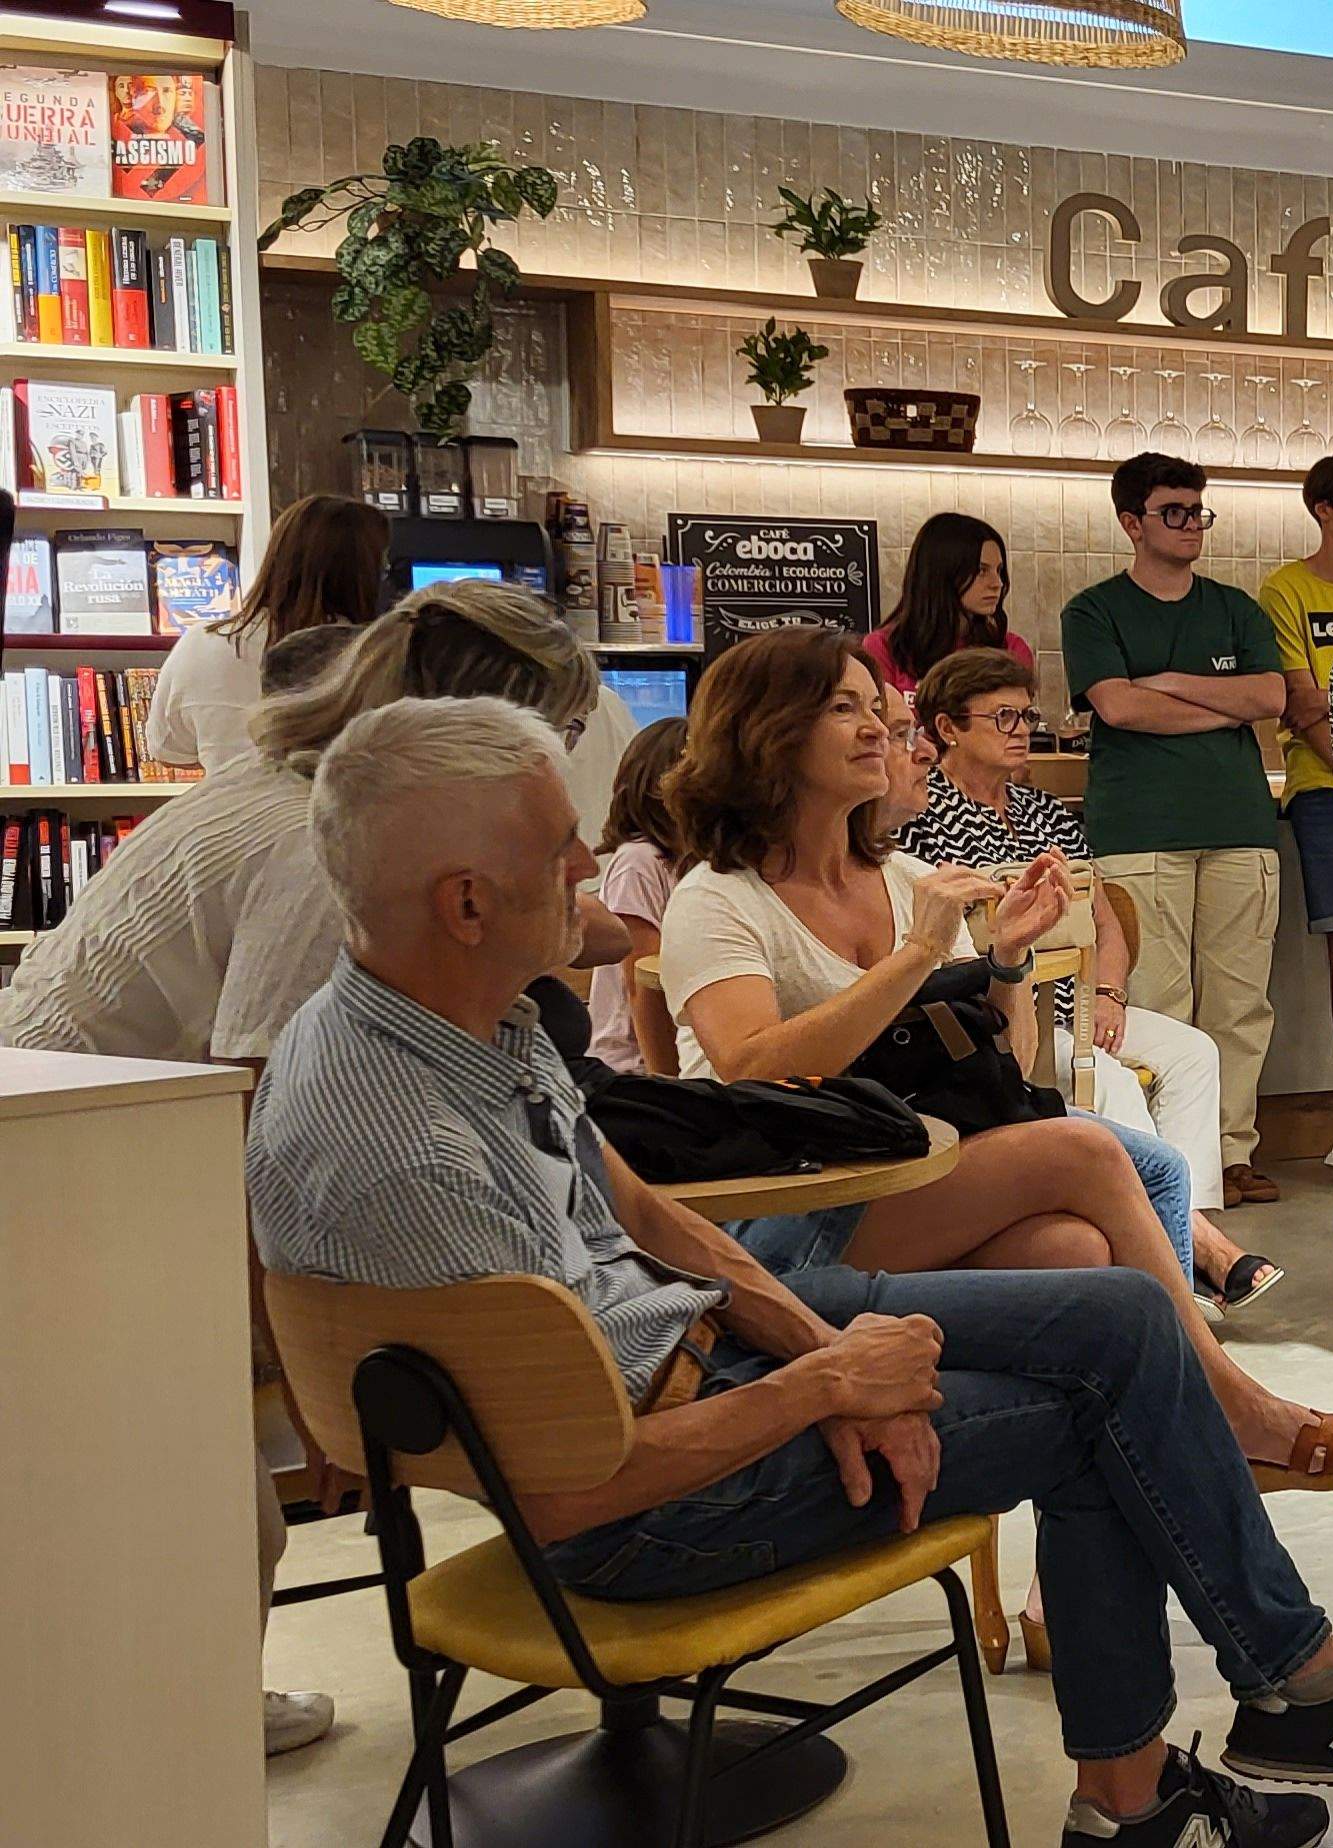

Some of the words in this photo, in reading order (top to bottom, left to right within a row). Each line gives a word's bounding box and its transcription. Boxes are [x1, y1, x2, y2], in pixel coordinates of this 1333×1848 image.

[0, 104, 96, 128] UERRA
[0, 125, 96, 146] UNDIAL
[112, 140, 196, 166] ASCISMO
[48, 403, 97, 419] NAZI
[759, 528, 790, 540] CAFÉ
[736, 534, 815, 561] eboca
[705, 562, 773, 578] Colombia
[782, 563, 846, 578] ECOLÓGICO
[63, 578, 145, 593] Revolución
[706, 578, 793, 594] COMERCIO
[796, 579, 846, 595] JUSTO
[87, 592, 122, 604] rusa
[1211, 655, 1237, 671] VAN
